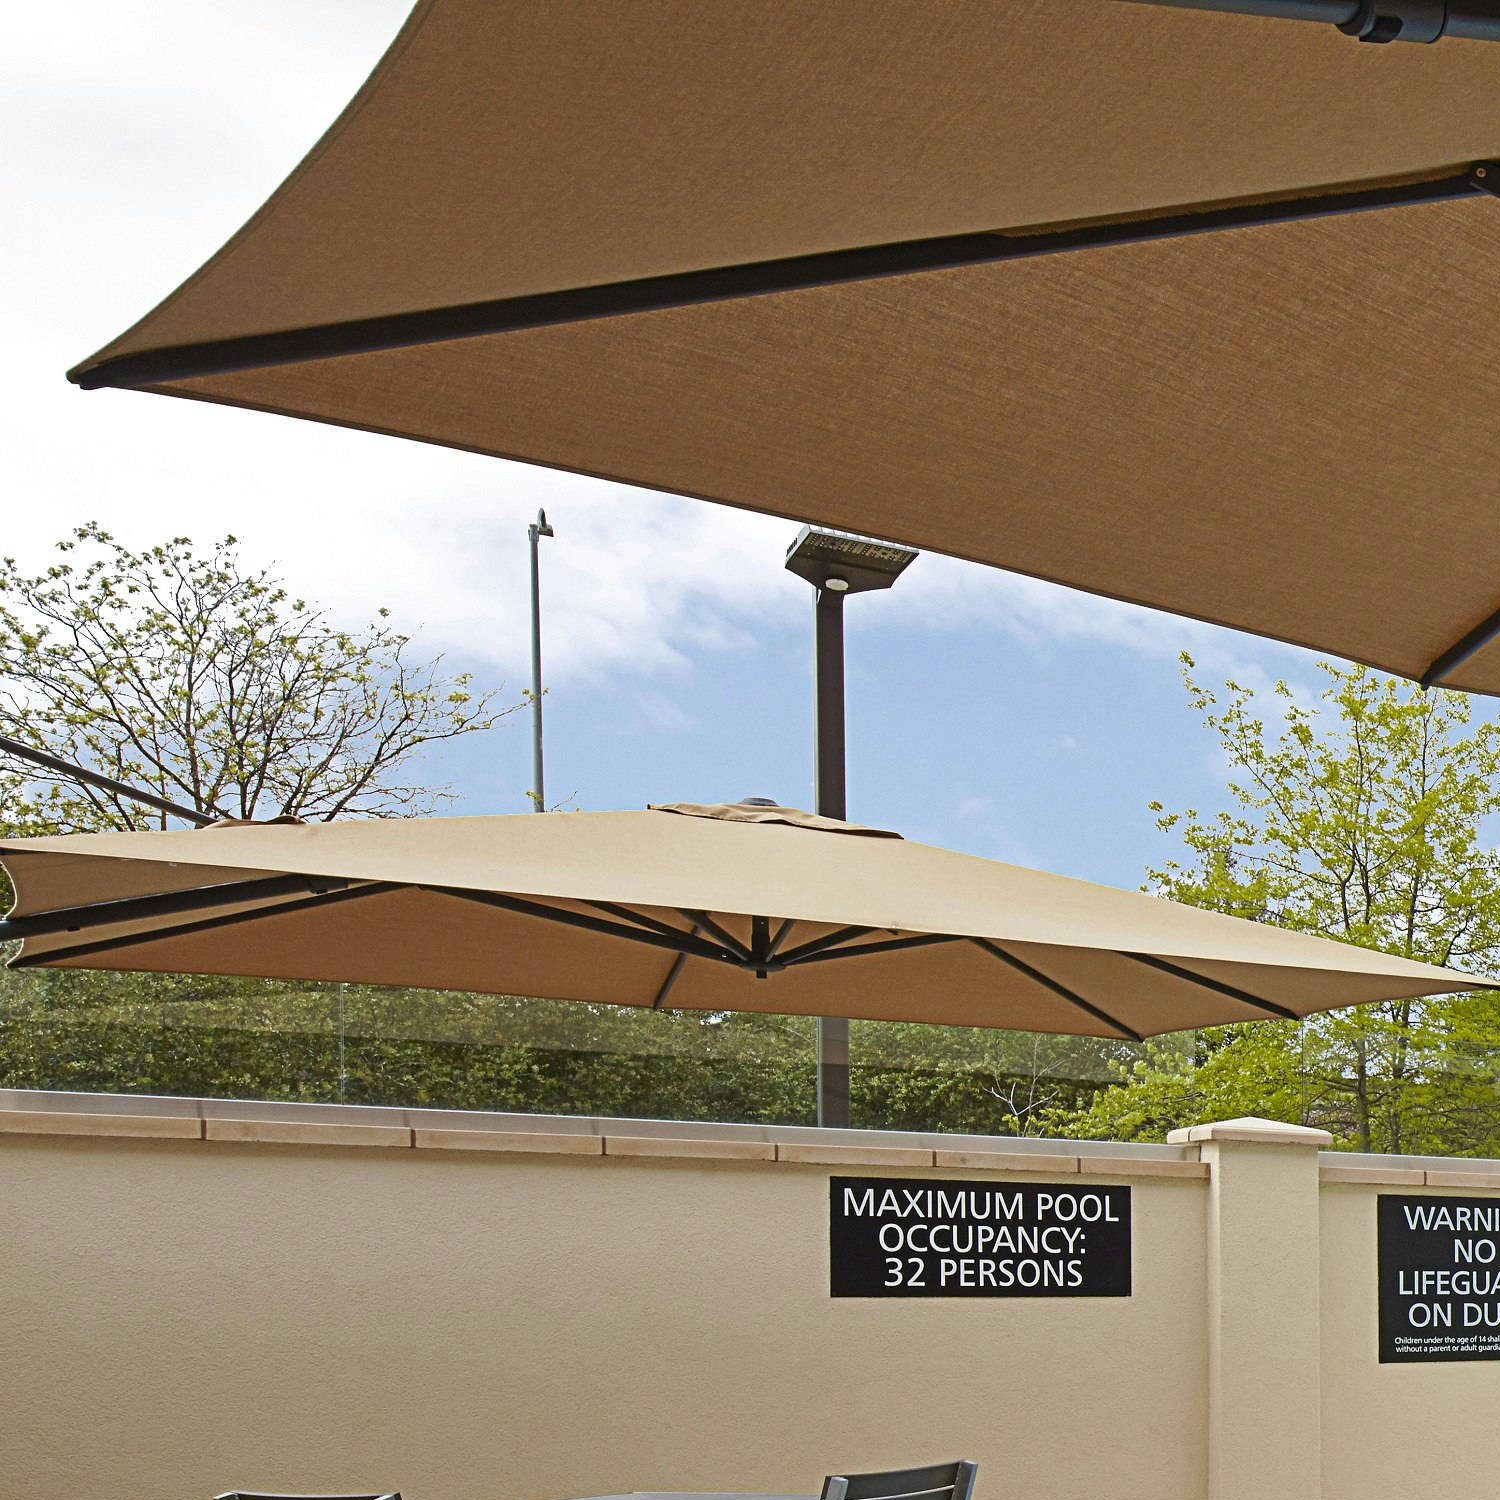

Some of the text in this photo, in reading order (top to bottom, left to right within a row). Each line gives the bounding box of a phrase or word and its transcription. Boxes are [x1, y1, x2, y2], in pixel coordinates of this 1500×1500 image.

[844, 1188, 1119, 1222] MAXIMUM POOL
[879, 1224, 1085, 1254] OCCUPANCY:
[1454, 1239, 1496, 1263] NO
[884, 1257, 1082, 1288] 32 PERSONS
[1409, 1302, 1452, 1328] ON
[1429, 1345, 1451, 1353] parent
[1460, 1343, 1477, 1351] adult
